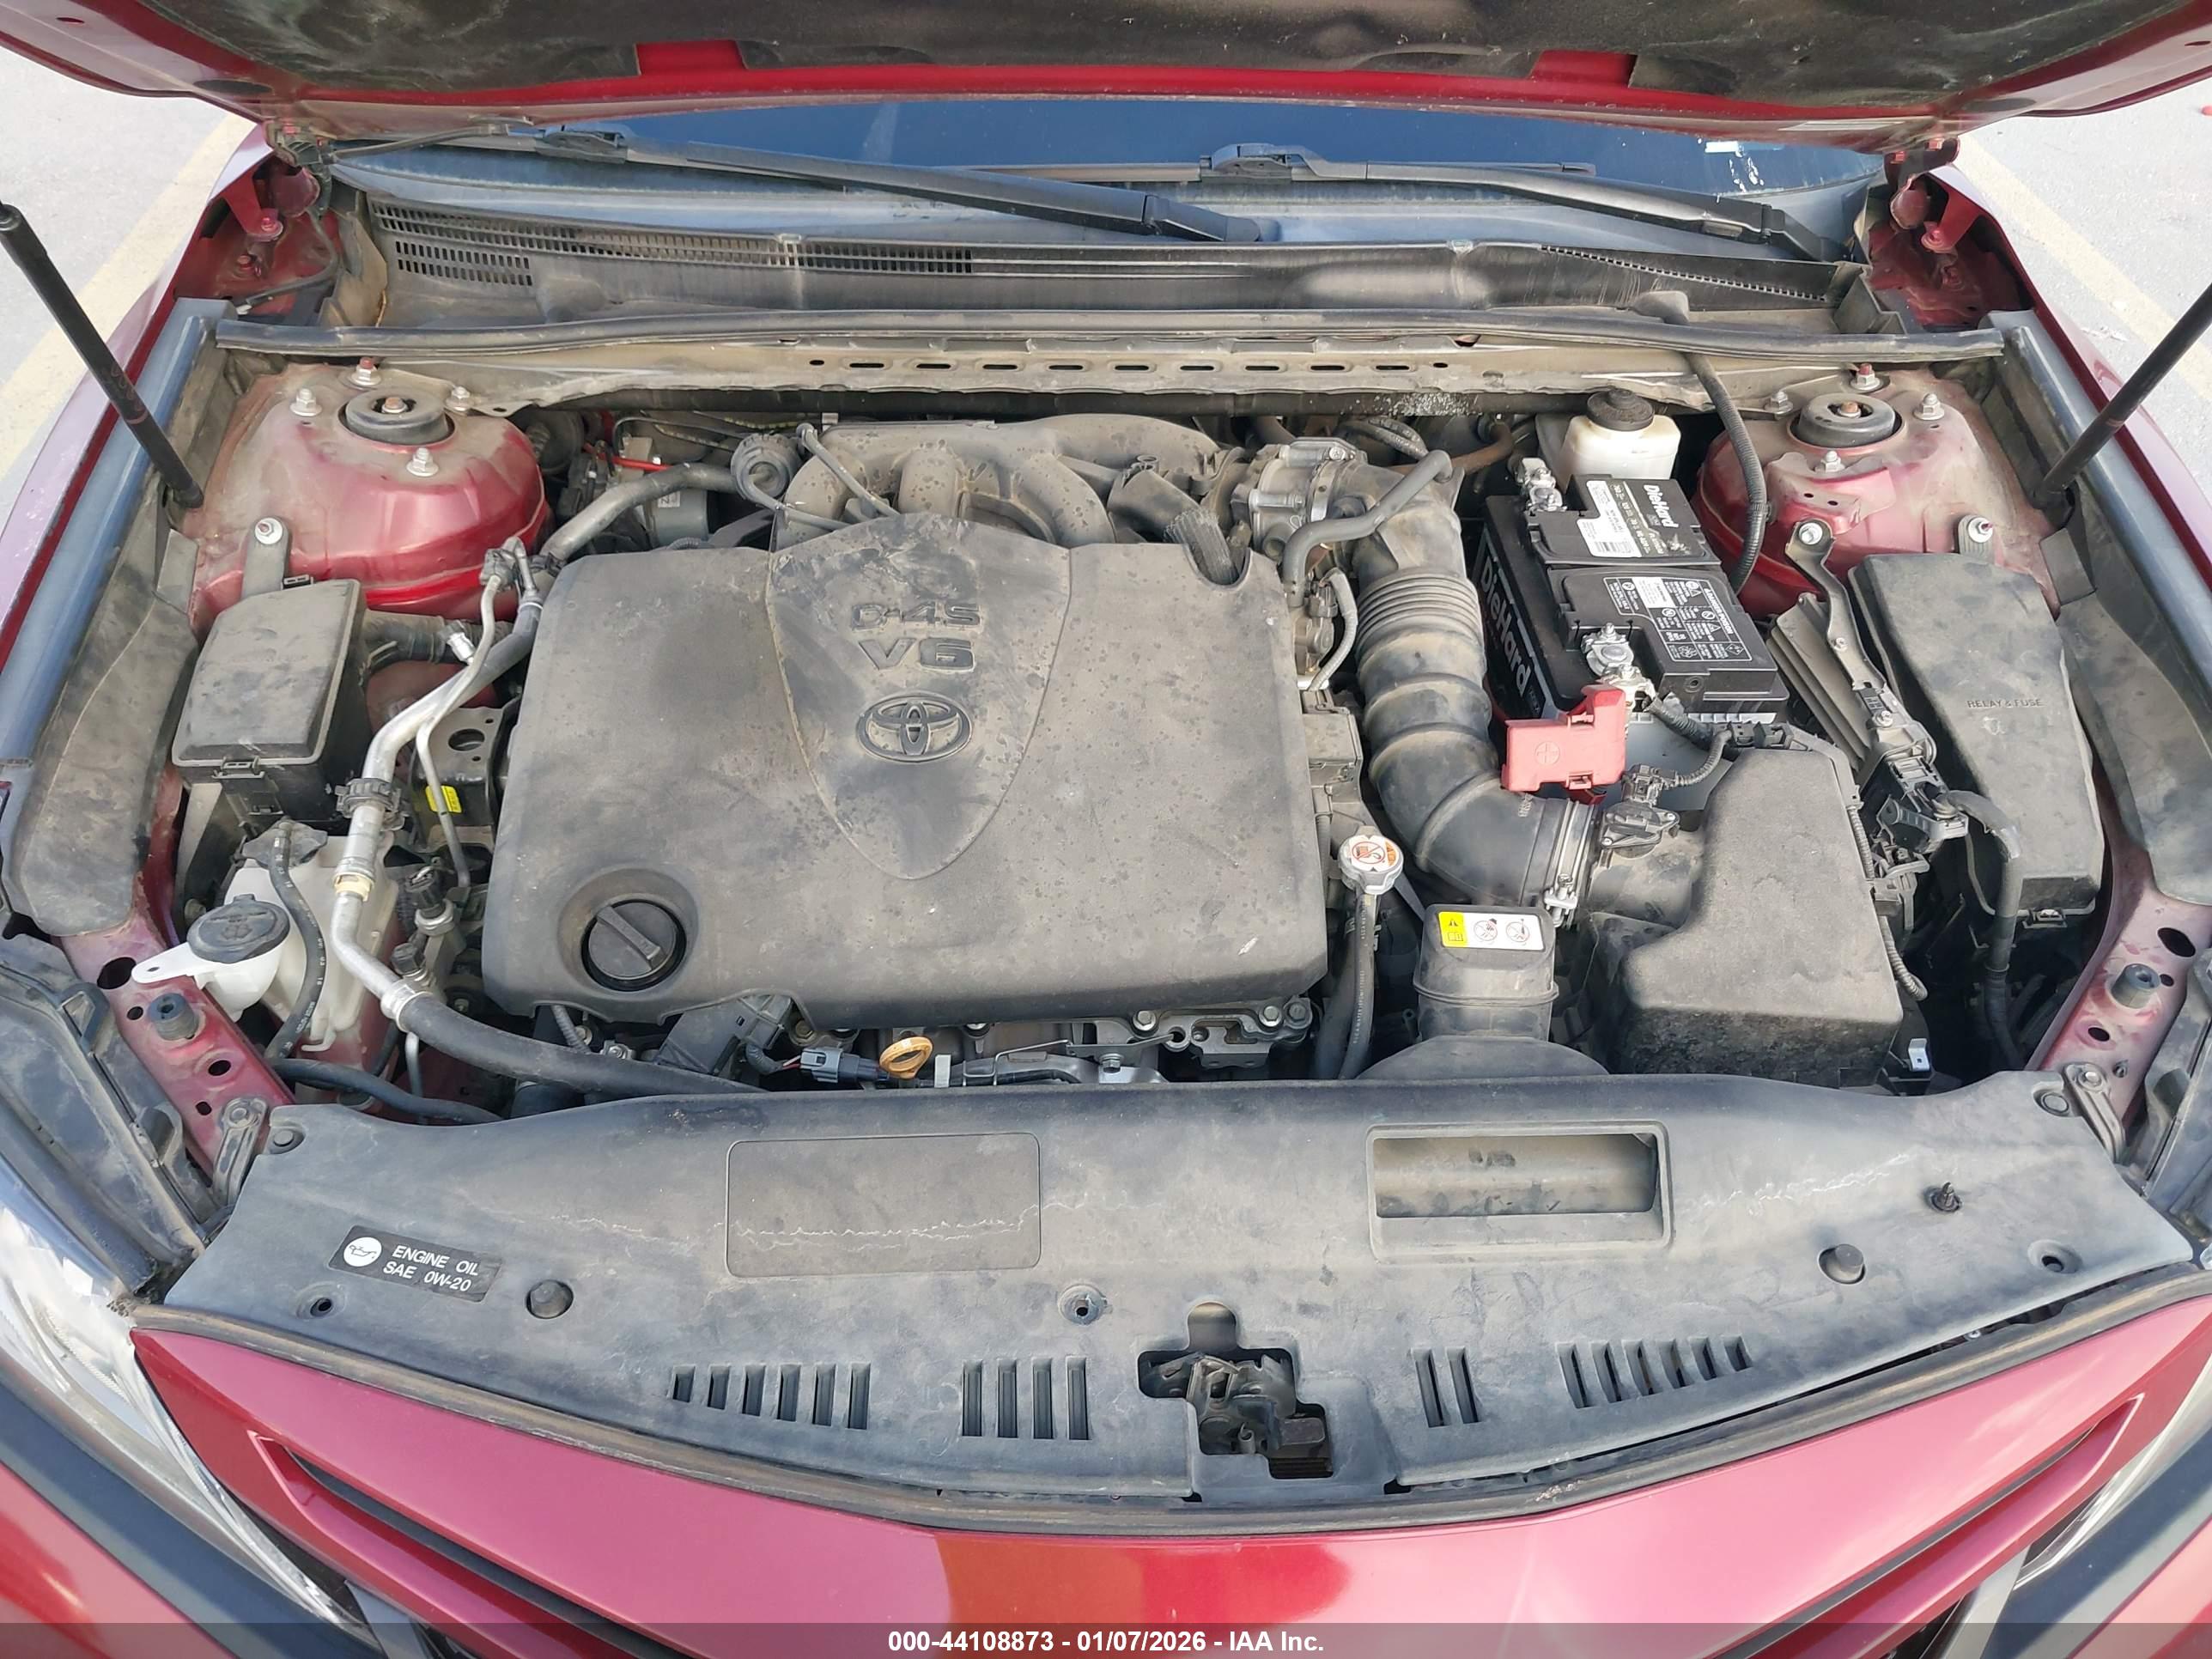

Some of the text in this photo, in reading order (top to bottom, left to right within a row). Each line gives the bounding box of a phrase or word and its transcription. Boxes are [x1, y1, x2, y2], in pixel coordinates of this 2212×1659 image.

[1644, 484, 1679, 528] DieHard
[1480, 556, 1531, 696] DieHard
[1718, 612, 1735, 635] POISON
[858, 636, 976, 673] V6
[1966, 700, 2002, 708] RELAY
[2014, 699, 2043, 708] FUSE
[392, 1244, 479, 1276] ENGINE OIL
[383, 1261, 471, 1292] SAE 0W-20
